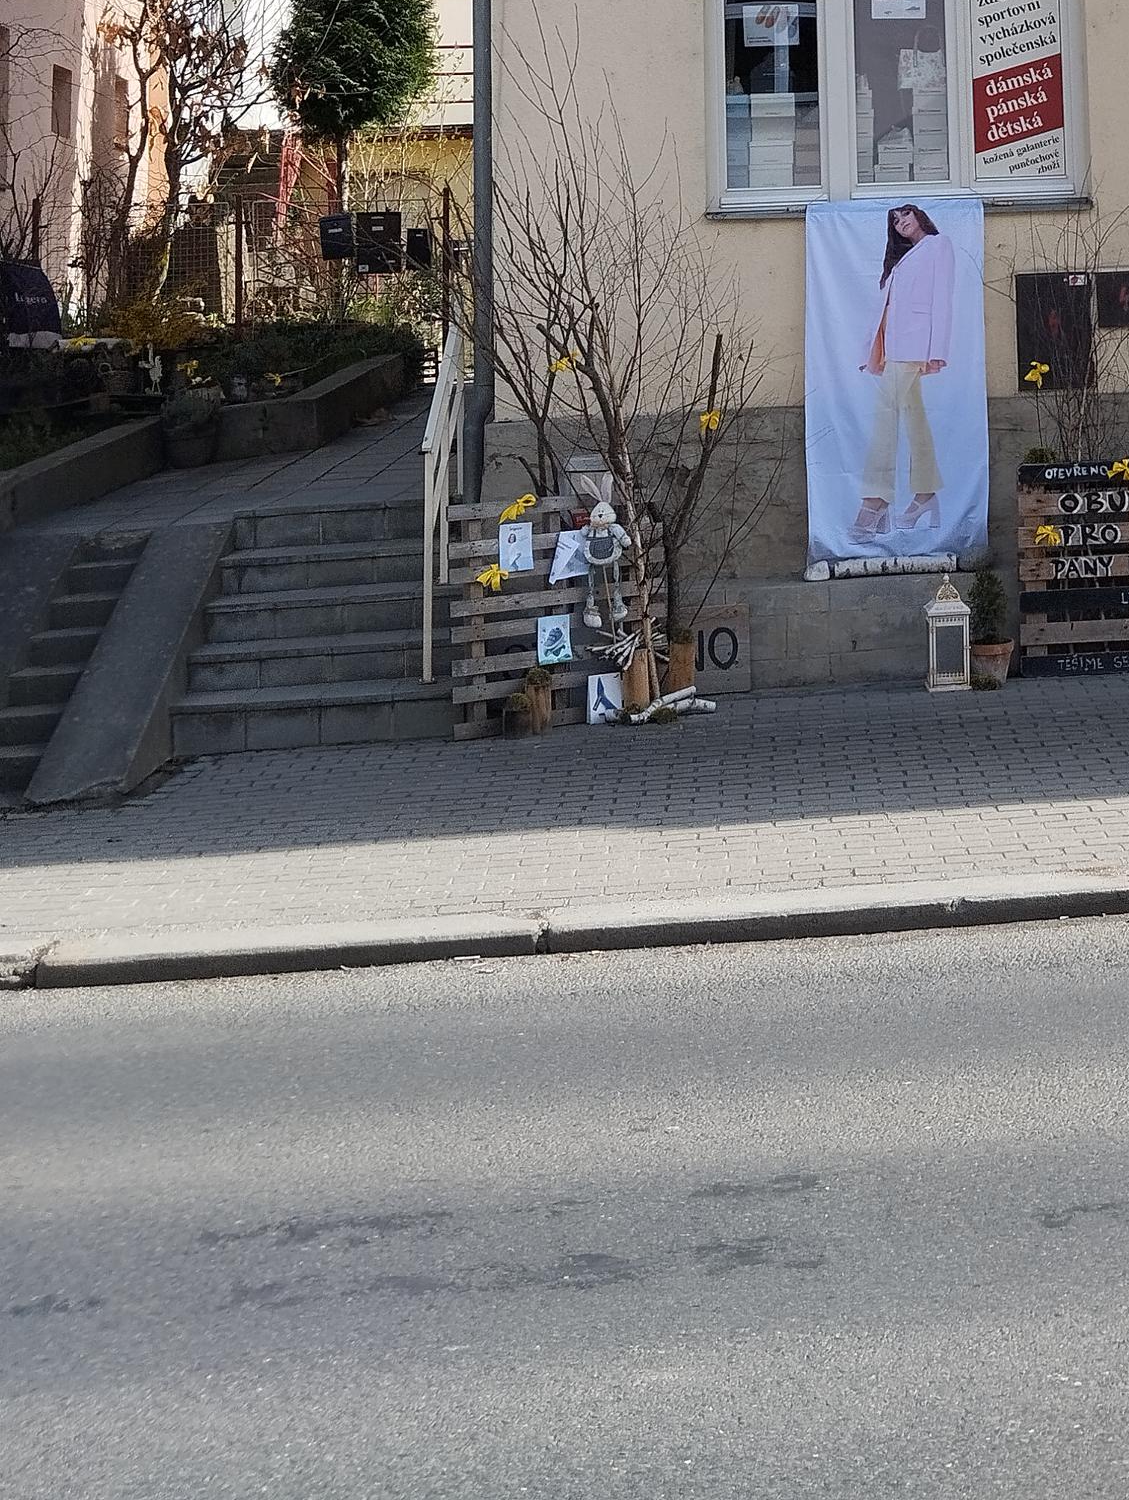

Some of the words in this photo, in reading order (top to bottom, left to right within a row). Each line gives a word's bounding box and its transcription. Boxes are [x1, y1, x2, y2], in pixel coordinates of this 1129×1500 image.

[979, 11, 1057, 46] vycházková
[978, 31, 1057, 66] společenská
[985, 62, 1053, 97] dámská
[985, 86, 1048, 122] pánská
[986, 111, 1043, 142] dětská
[982, 148, 1014, 165] kožená
[1016, 135, 1060, 156] galanterie
[1008, 148, 1060, 174] punčochové
[1037, 160, 1060, 175] zboží
[1060, 523, 1121, 547] PRO
[1113, 655, 1129, 668] SE
